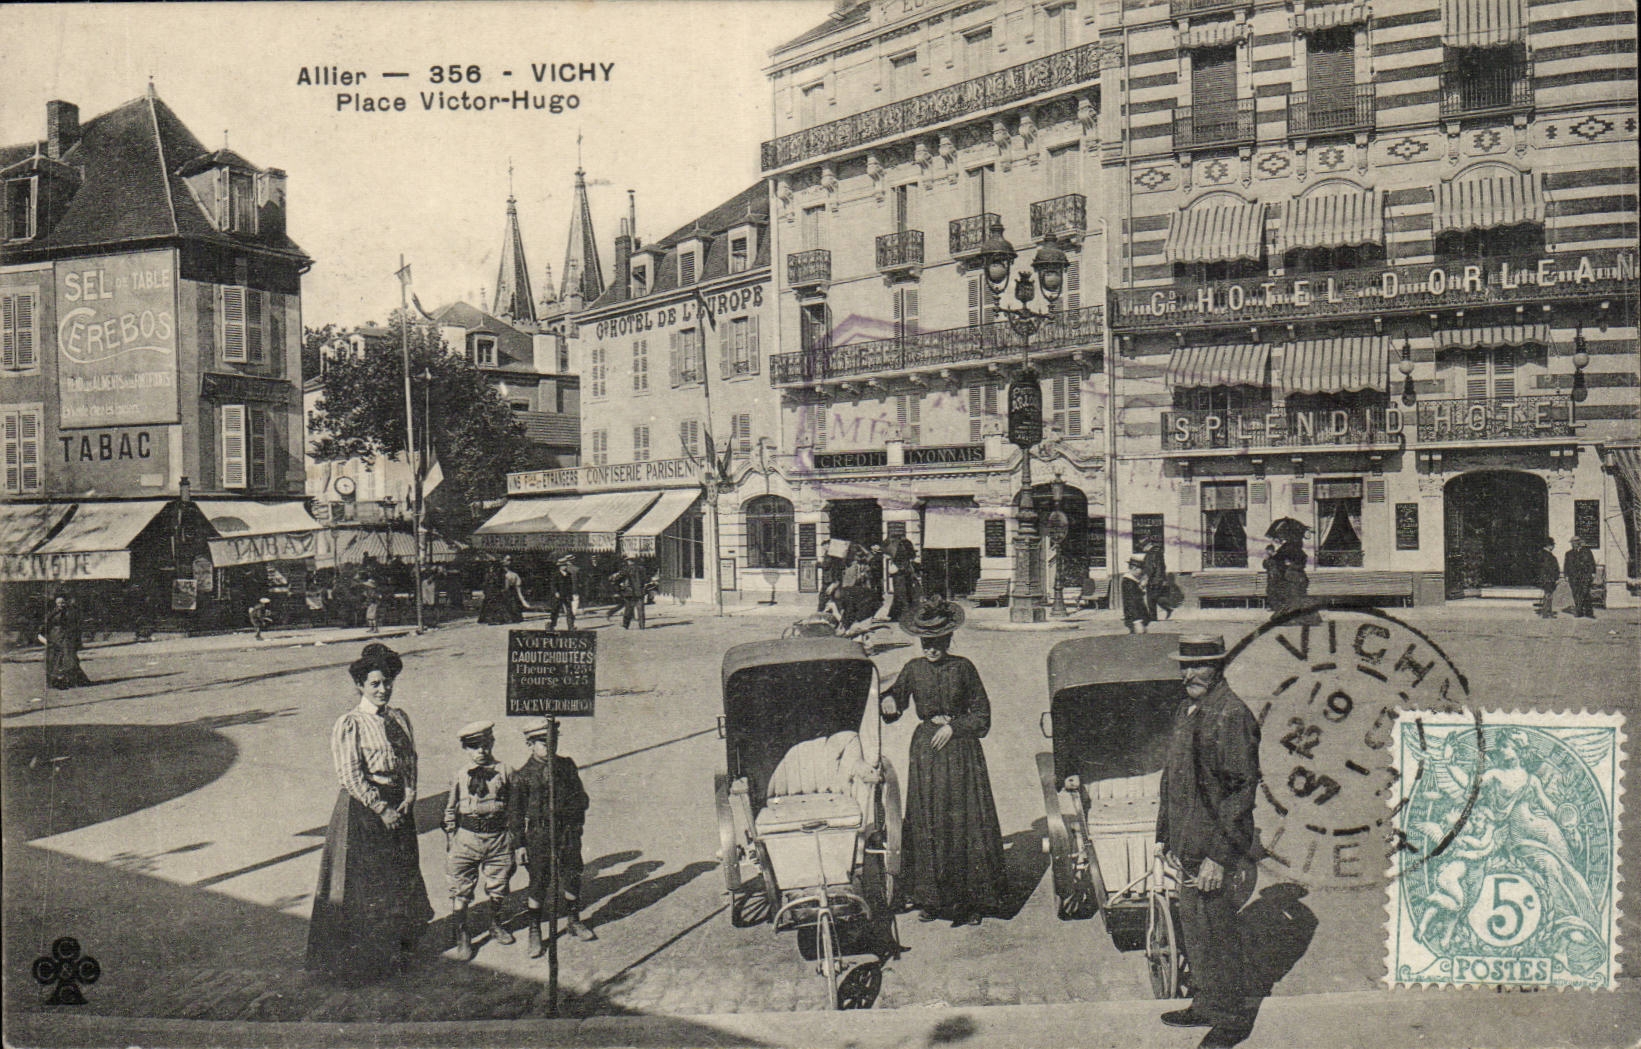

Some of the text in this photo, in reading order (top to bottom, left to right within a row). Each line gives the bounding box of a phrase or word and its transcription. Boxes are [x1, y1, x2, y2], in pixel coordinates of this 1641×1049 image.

[64, 269, 113, 302] SEL
[131, 268, 170, 289] TABLE
[1198, 278, 1343, 312] HOTEL
[58, 306, 172, 364] CEREBOS
[610, 311, 653, 338] HOTEL
[658, 308, 677, 328] DE
[1175, 401, 1587, 442] SPLENDID HOTEL
[59, 431, 151, 462] TABAC
[909, 447, 983, 465] LYONNAIS
[586, 463, 641, 484] CONFISERIE
[516, 637, 588, 649] VOITURES
[1455, 959, 1548, 981] POSTES
